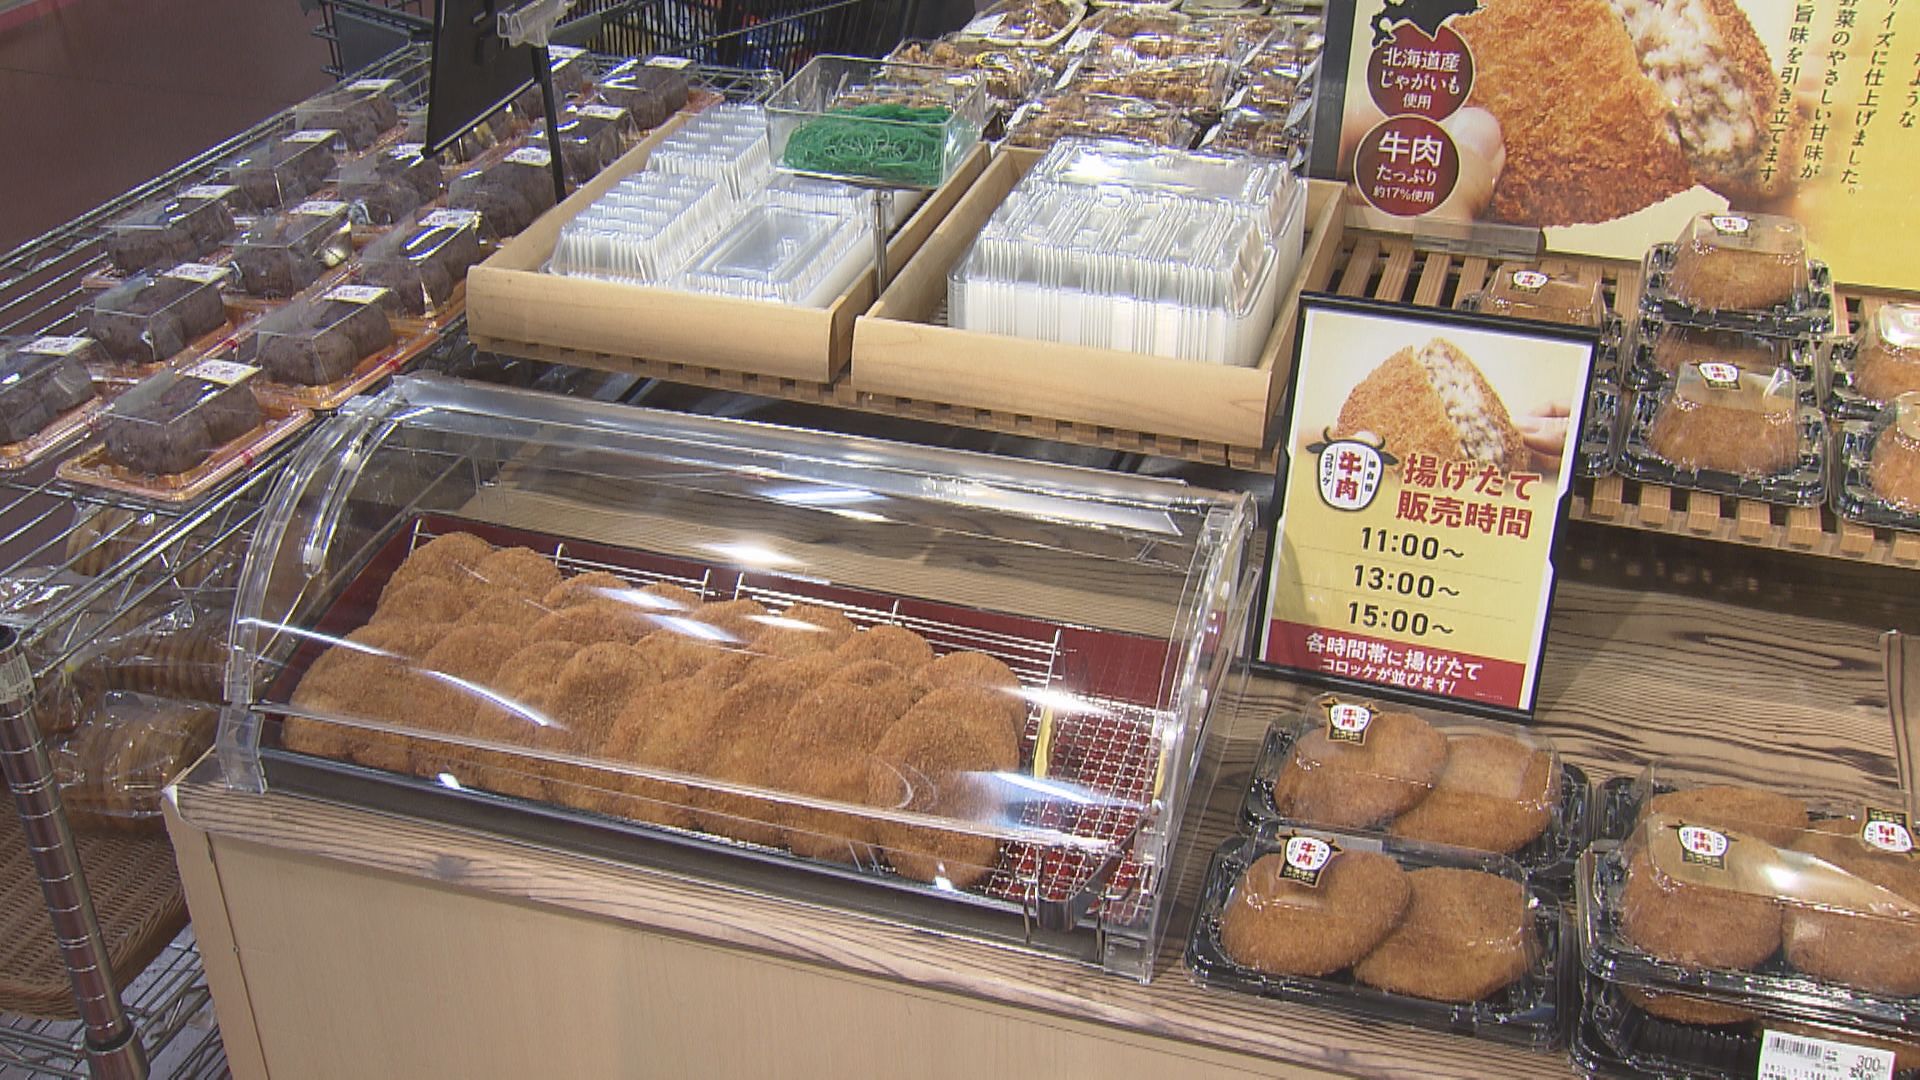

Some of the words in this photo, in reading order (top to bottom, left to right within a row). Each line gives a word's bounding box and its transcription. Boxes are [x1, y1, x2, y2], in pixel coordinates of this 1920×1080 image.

[1382, 47, 1460, 72] 北海道産
[1380, 69, 1460, 95] じゃがいも
[1403, 93, 1432, 110] 使用
[1378, 131, 1443, 167] 牛肉
[1376, 163, 1437, 186] たっぷり
[1322, 453, 1334, 486] コロッケ
[1335, 451, 1361, 500] 牛肉
[1403, 453, 1541, 501] 揚げたて
[1396, 491, 1533, 540] 販売時間
[1306, 632, 1483, 681] 各時間帯に揚げたて
[1856, 1055, 1880, 1072] 300
